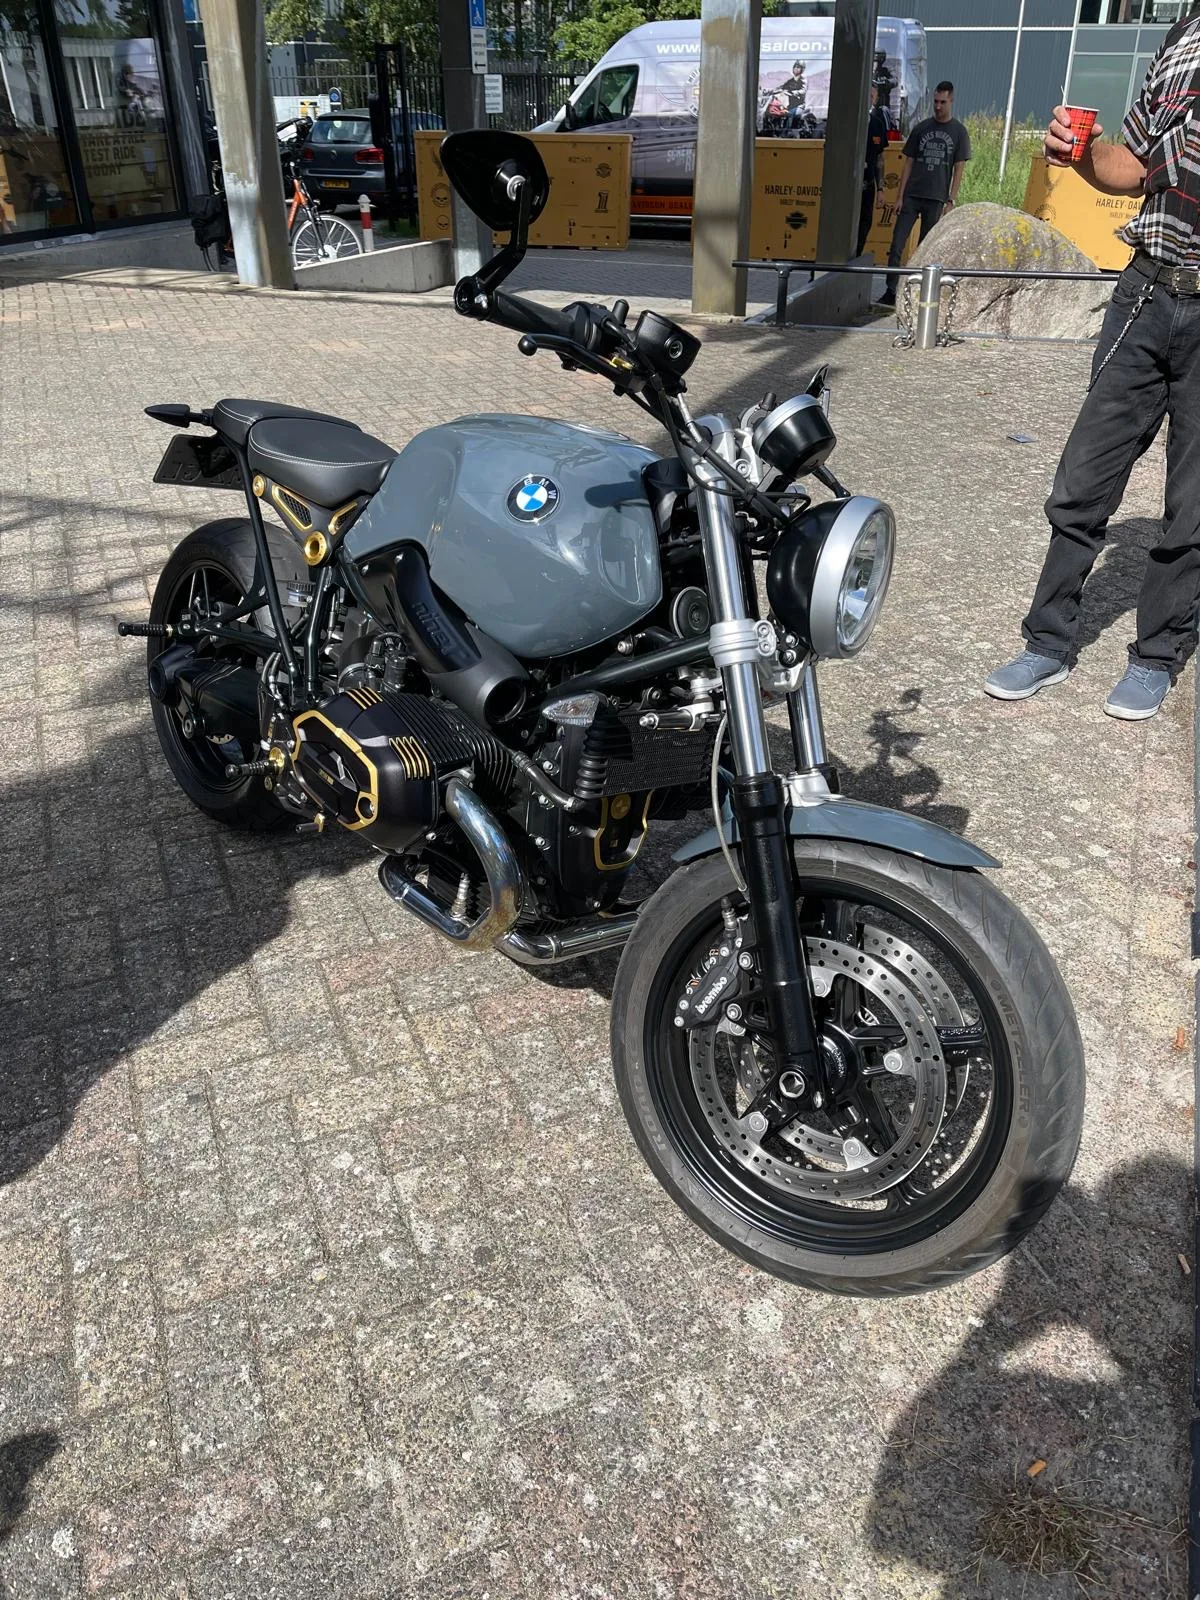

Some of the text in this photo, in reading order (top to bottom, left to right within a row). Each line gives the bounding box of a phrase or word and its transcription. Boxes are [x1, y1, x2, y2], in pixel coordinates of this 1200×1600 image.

[83, 146, 136, 163] TEST RIDE
[763, 184, 823, 197] HARLEY-DAVIDS
[524, 477, 557, 500] BMW
[695, 976, 728, 1014] brembo
[997, 992, 1030, 1113] METZELER
